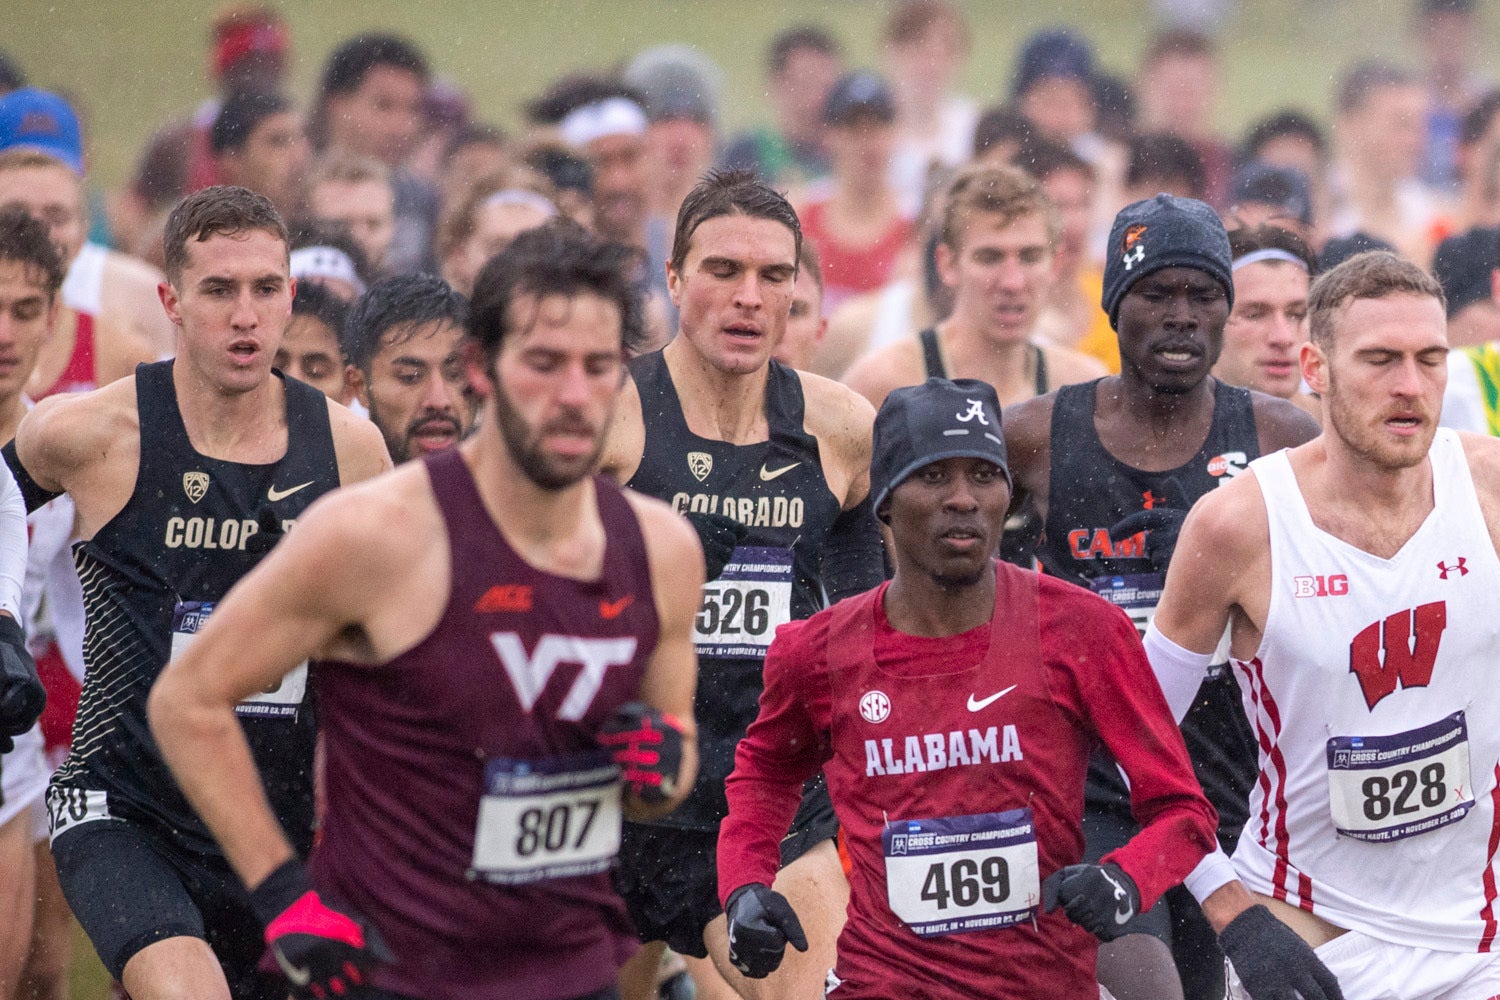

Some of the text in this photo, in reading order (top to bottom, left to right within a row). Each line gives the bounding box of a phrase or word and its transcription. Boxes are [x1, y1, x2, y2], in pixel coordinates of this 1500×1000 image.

[956, 398, 989, 425] A
[189, 485, 202, 497] 12
[1068, 528, 1152, 559] CAM
[741, 563, 792, 573] CHAMPIONSHIPS
[695, 588, 770, 636] 526
[1349, 600, 1447, 713] W
[489, 631, 638, 722] VT
[235, 705, 270, 714] NOVEMBER
[861, 693, 889, 722] SEC
[864, 724, 1023, 777] ALABAMA
[1350, 752, 1376, 762] CROSS
[1377, 747, 1410, 761] COUNTRY
[1411, 726, 1463, 753] CHAMPIONSHIPS
[1362, 762, 1446, 821] 828
[47, 786, 88, 837] 20
[516, 800, 600, 857] 807
[908, 836, 934, 847] CROSS
[935, 833, 970, 845] COUNTRY
[970, 824, 1031, 841] CHAMPIONSHIPS
[1367, 830, 1391, 840] HAUTE,
[1392, 828, 1400, 838] IN
[1405, 818, 1440, 834] NOVEMBER
[921, 856, 1011, 910] 469
[926, 923, 949, 934] HAUTE,
[950, 921, 959, 930] IN
[964, 917, 1003, 929] NOVEMBER
